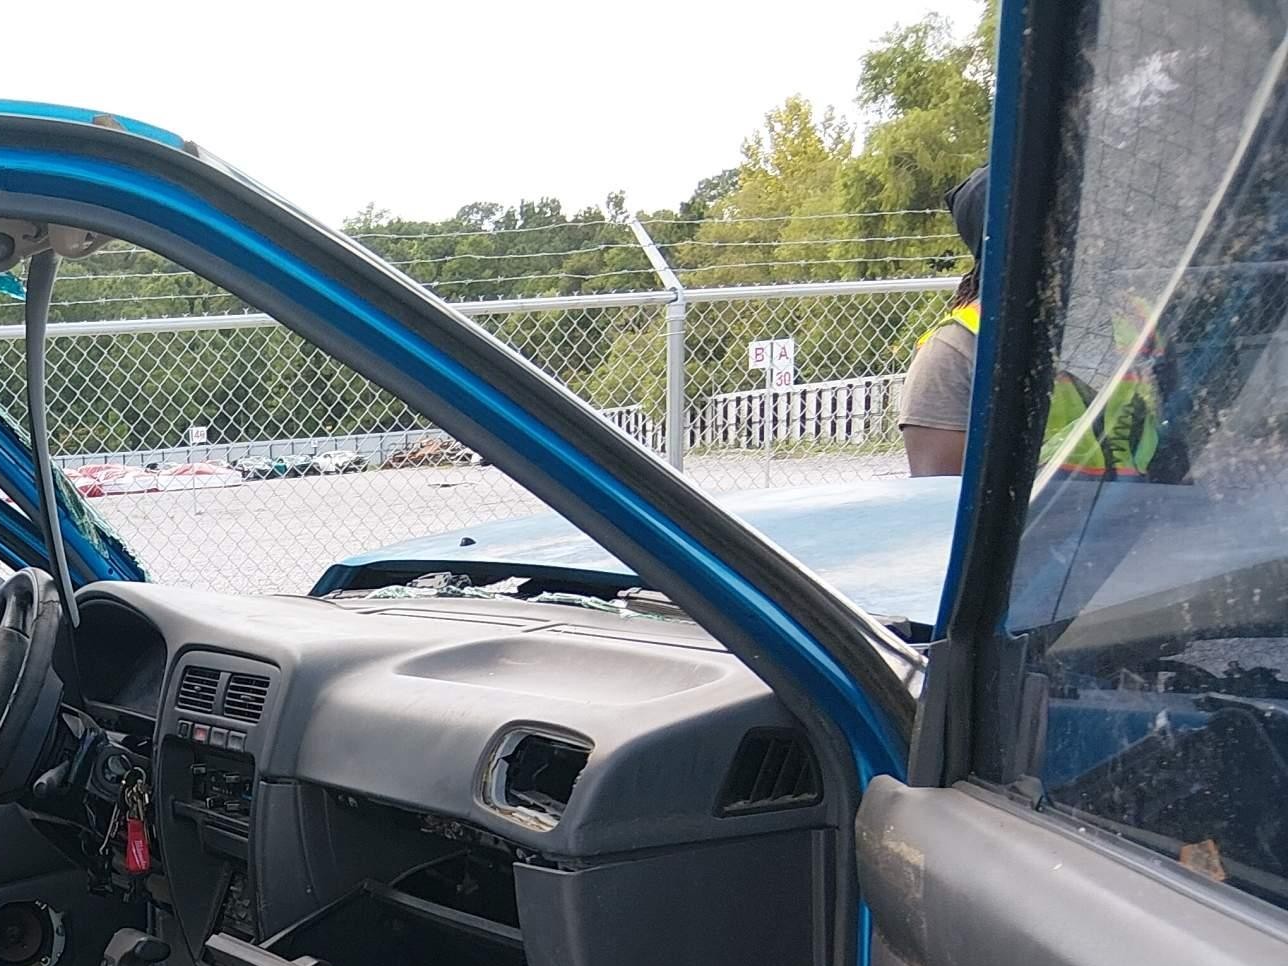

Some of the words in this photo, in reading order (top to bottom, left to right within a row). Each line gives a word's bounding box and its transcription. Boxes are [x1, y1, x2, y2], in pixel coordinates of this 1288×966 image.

[754, 346, 765, 363] B
[778, 345, 790, 361] A
[775, 370, 791, 387] 30
